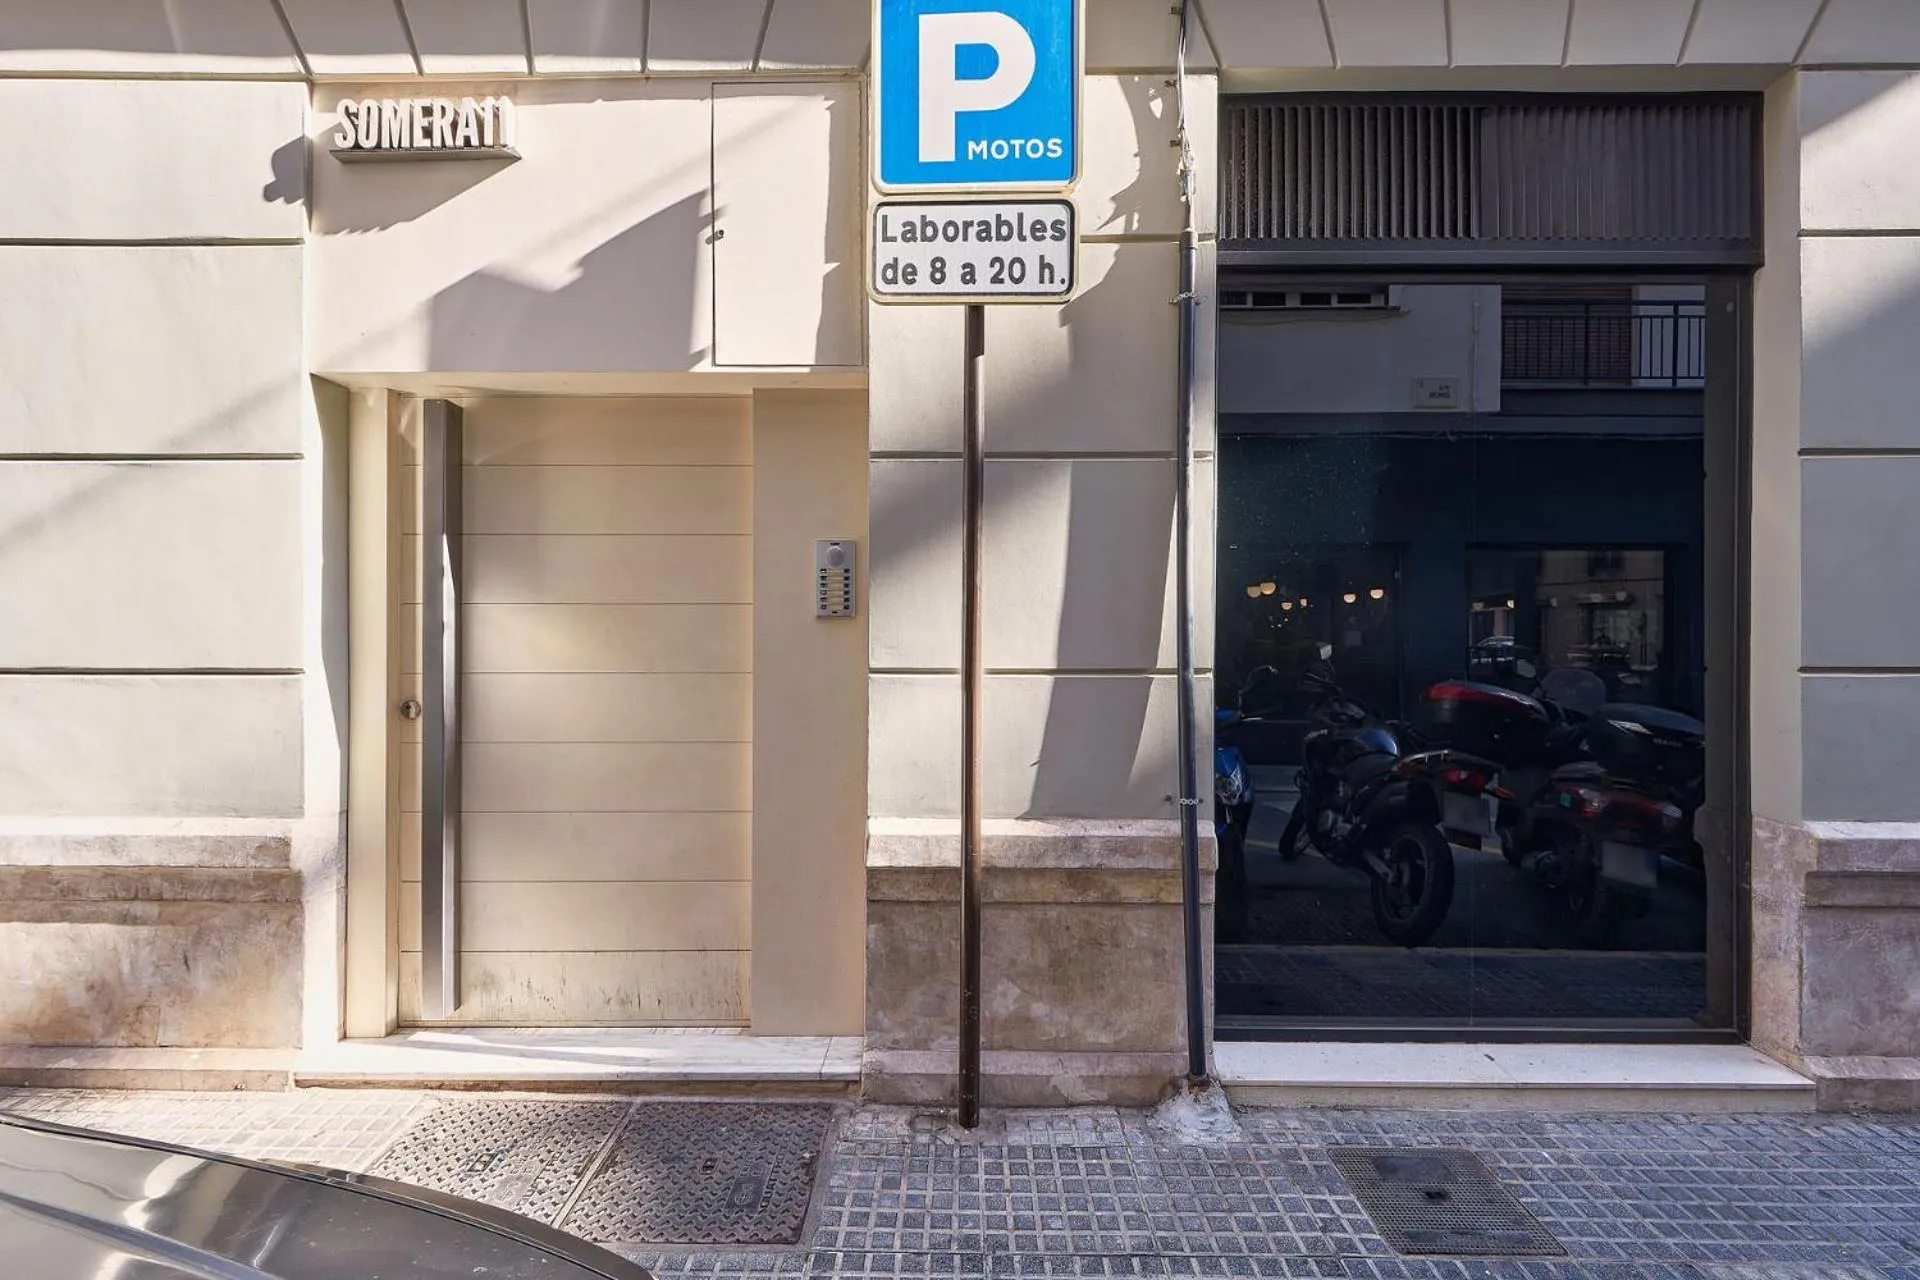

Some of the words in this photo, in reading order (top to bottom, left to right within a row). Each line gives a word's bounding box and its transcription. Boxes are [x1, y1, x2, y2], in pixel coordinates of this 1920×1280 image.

[919, 11, 1036, 163] P
[967, 138, 1063, 161] MOTOS
[881, 212, 1067, 243] Laborables
[881, 257, 918, 285] de
[930, 257, 947, 285] 8
[960, 263, 976, 285] a
[989, 257, 1026, 285] 20
[1039, 255, 1066, 285] h.
